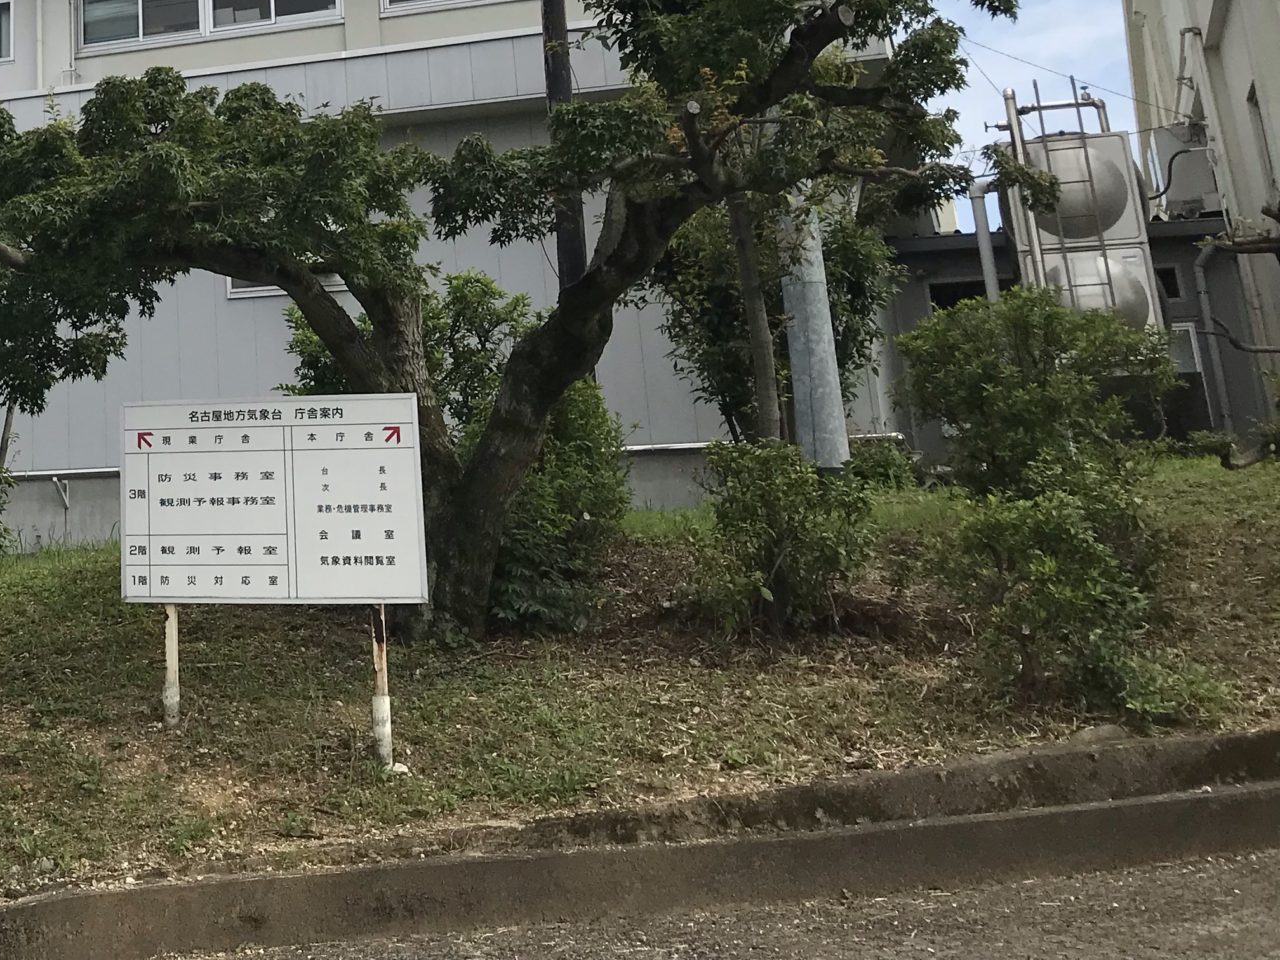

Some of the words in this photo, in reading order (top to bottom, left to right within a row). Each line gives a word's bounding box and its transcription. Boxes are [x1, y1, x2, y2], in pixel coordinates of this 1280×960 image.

[188, 408, 282, 423] 名古屋地方気象台
[294, 407, 344, 420] 庁舎案内
[161, 433, 251, 446] 現業庁舎
[307, 431, 374, 442] 本庁舎
[157, 470, 276, 483] 防災事務室
[128, 489, 147, 499] 3階
[159, 496, 276, 507] 観測予報事務室
[319, 529, 395, 540] 会議室
[128, 544, 147, 556] 2階
[160, 545, 279, 556] 観測予報室
[320, 555, 396, 566] 気象資料閲覧室
[131, 574, 148, 586] 1階
[160, 574, 279, 586] 防災対応室
